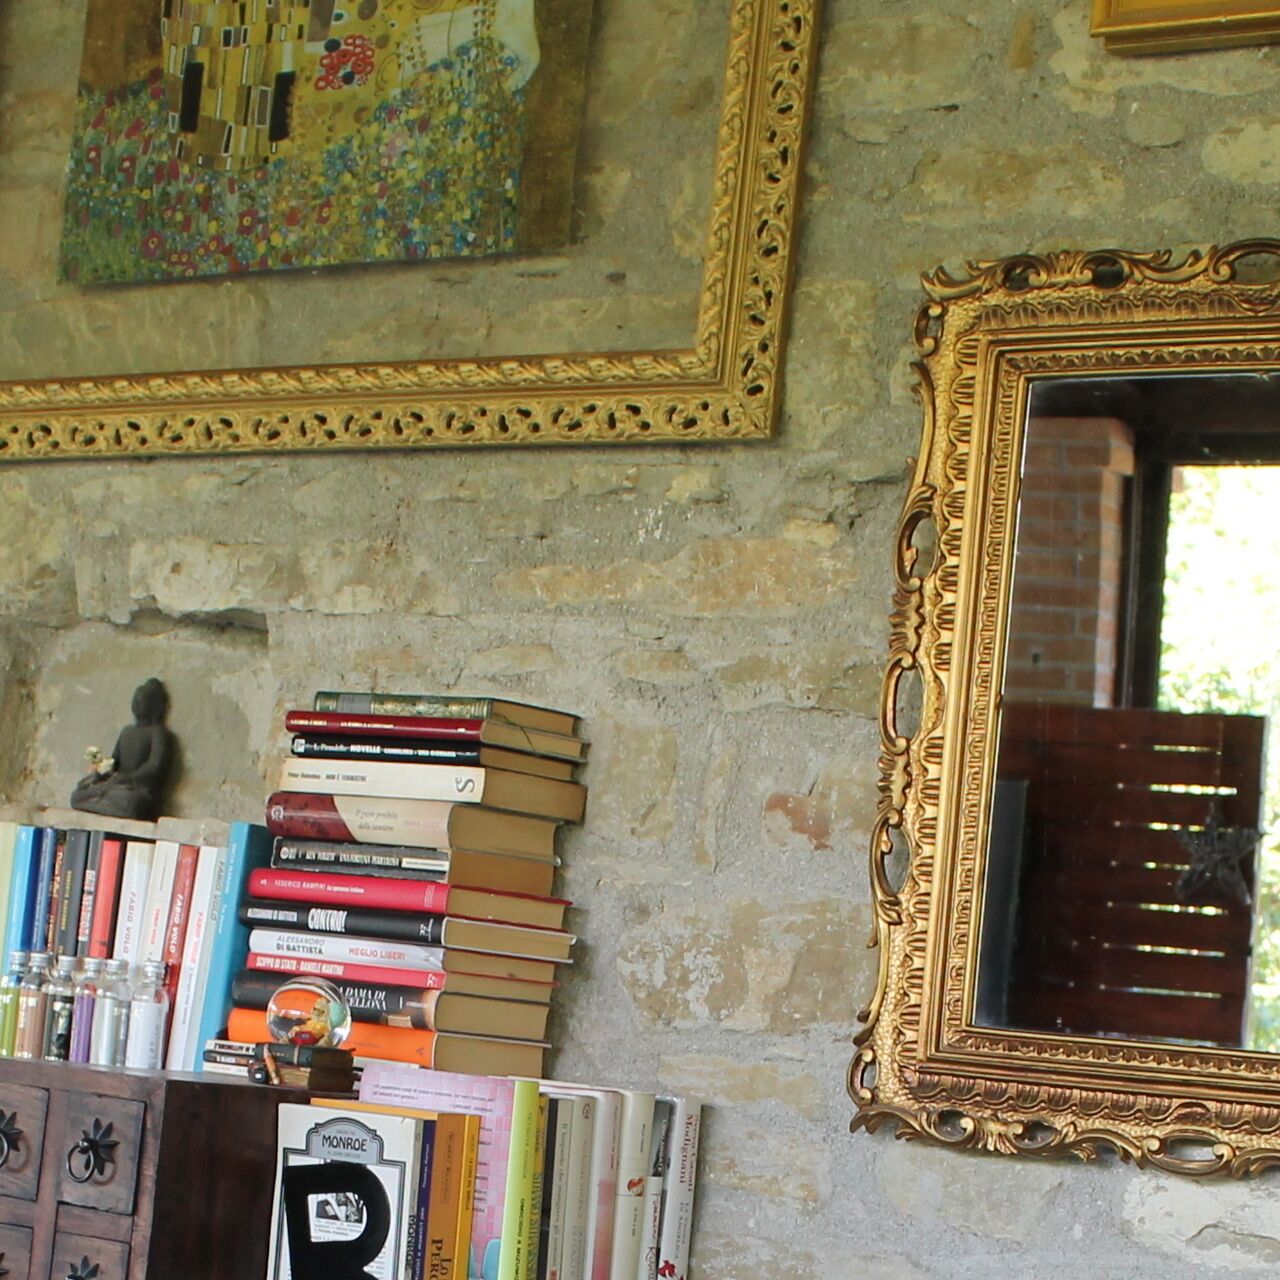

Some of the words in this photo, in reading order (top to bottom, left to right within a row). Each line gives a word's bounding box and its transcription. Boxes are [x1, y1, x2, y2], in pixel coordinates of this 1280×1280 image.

[212, 860, 228, 892] FABIO
[125, 891, 138, 922] FABIO
[172, 893, 184, 924] FABIO
[206, 893, 221, 921] VOLO
[193, 911, 205, 938] FABIO
[120, 925, 133, 954] VOLO
[168, 925, 179, 953] VOLO
[189, 939, 200, 963] VOLO
[275, 941, 288, 951] DI
[288, 943, 325, 956] BATTISTA
[276, 932, 326, 947] ALESSANDRO
[347, 944, 379, 958] MEGLIO
[379, 949, 407, 961] LIBERI
[322, 1134, 368, 1152] MONROE
[677, 1112, 694, 1185] Modignani
[515, 1197, 526, 1238] OMICIDIO
